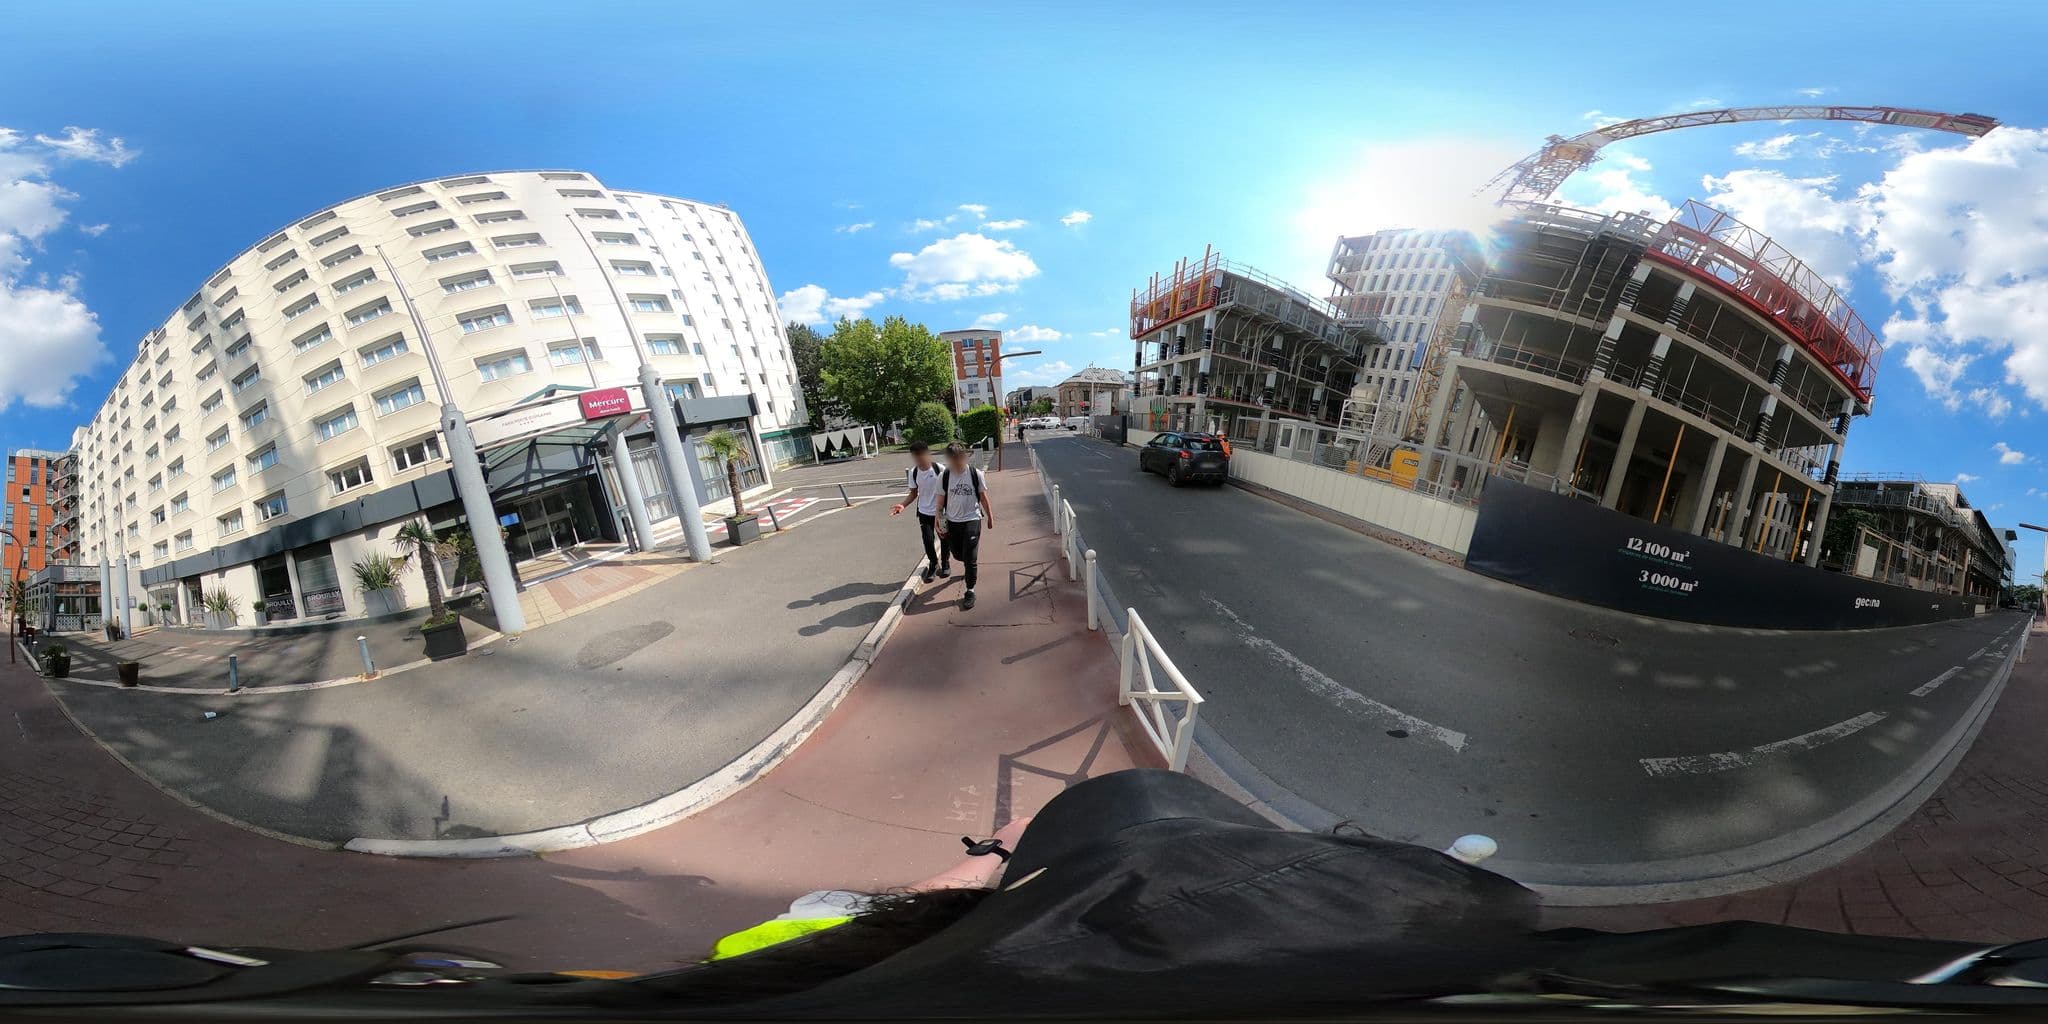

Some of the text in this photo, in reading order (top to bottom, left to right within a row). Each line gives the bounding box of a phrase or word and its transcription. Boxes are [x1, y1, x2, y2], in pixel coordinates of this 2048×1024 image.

[588, 397, 625, 409] Mercure
[1638, 569, 1649, 582] 3
[1650, 573, 1679, 588] 000
[307, 590, 340, 602] BROUILLY
[1854, 596, 1881, 609] gecina
